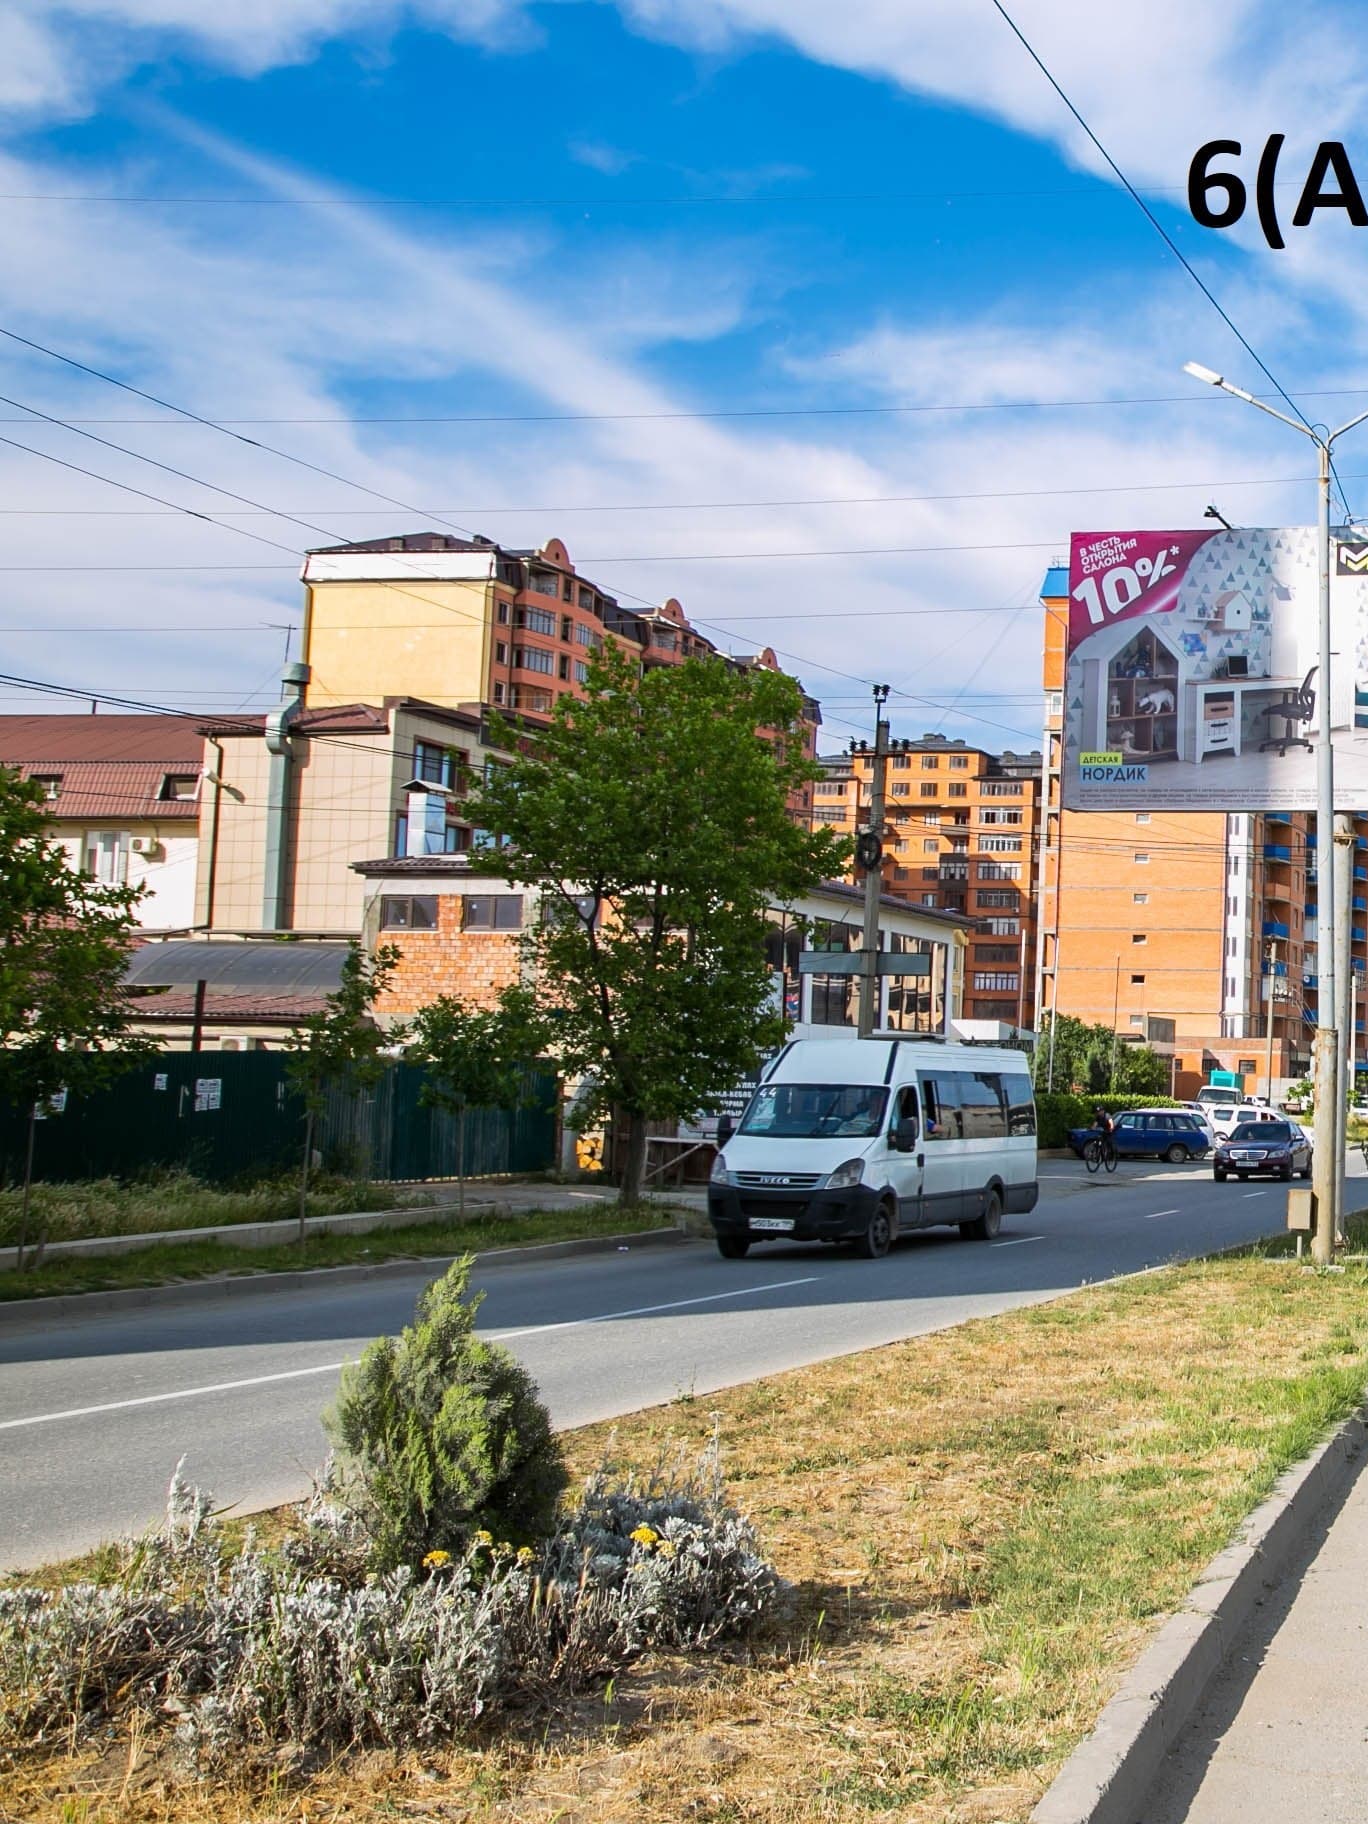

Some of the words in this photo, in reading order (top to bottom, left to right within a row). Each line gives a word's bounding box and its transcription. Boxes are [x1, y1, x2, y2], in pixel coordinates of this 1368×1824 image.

[1079, 547, 1087, 557] В
[1088, 536, 1121, 552] ЧЕСТЬ
[1081, 538, 1137, 565] ОТКРЫТИЯ
[1082, 554, 1127, 575] САЛОНА
[1083, 755, 1119, 764] ДЕТСКАЯ
[1082, 767, 1146, 782] НОРДИК
[760, 1176, 790, 1185] IVECO
